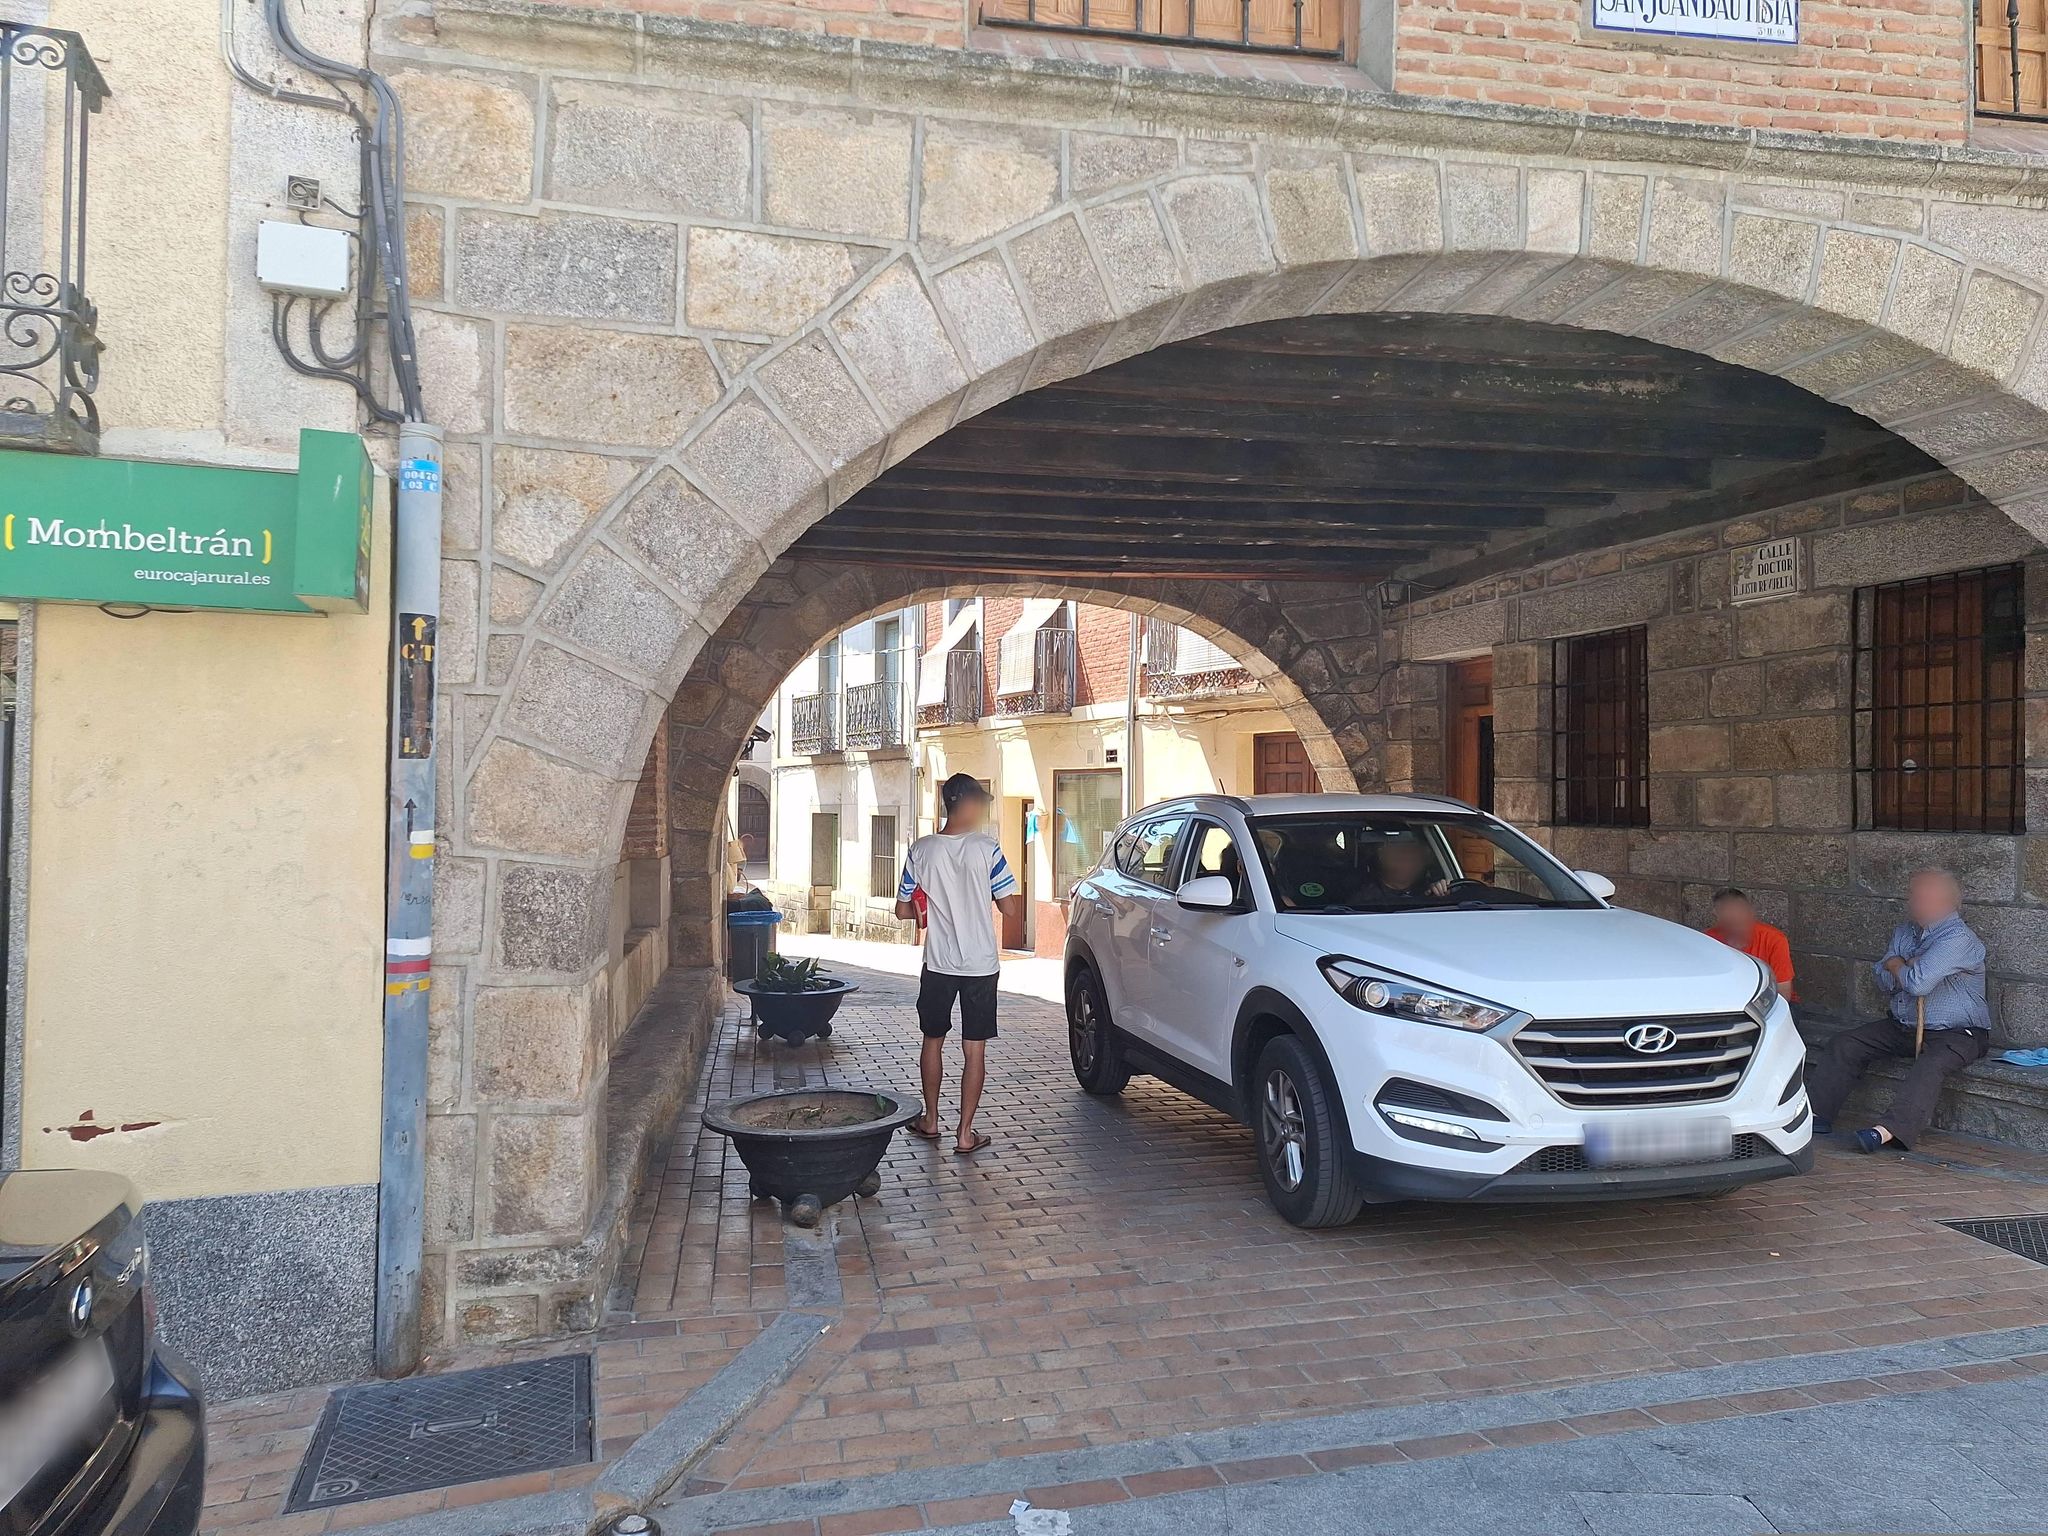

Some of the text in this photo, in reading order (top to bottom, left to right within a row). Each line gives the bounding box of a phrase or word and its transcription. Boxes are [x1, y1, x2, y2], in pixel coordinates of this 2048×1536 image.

[27, 517, 254, 557] Mombeltrán
[1760, 543, 1792, 560] CALLE
[1758, 558, 1793, 576] DOCTOR
[134, 568, 271, 586] eurocajarural.es
